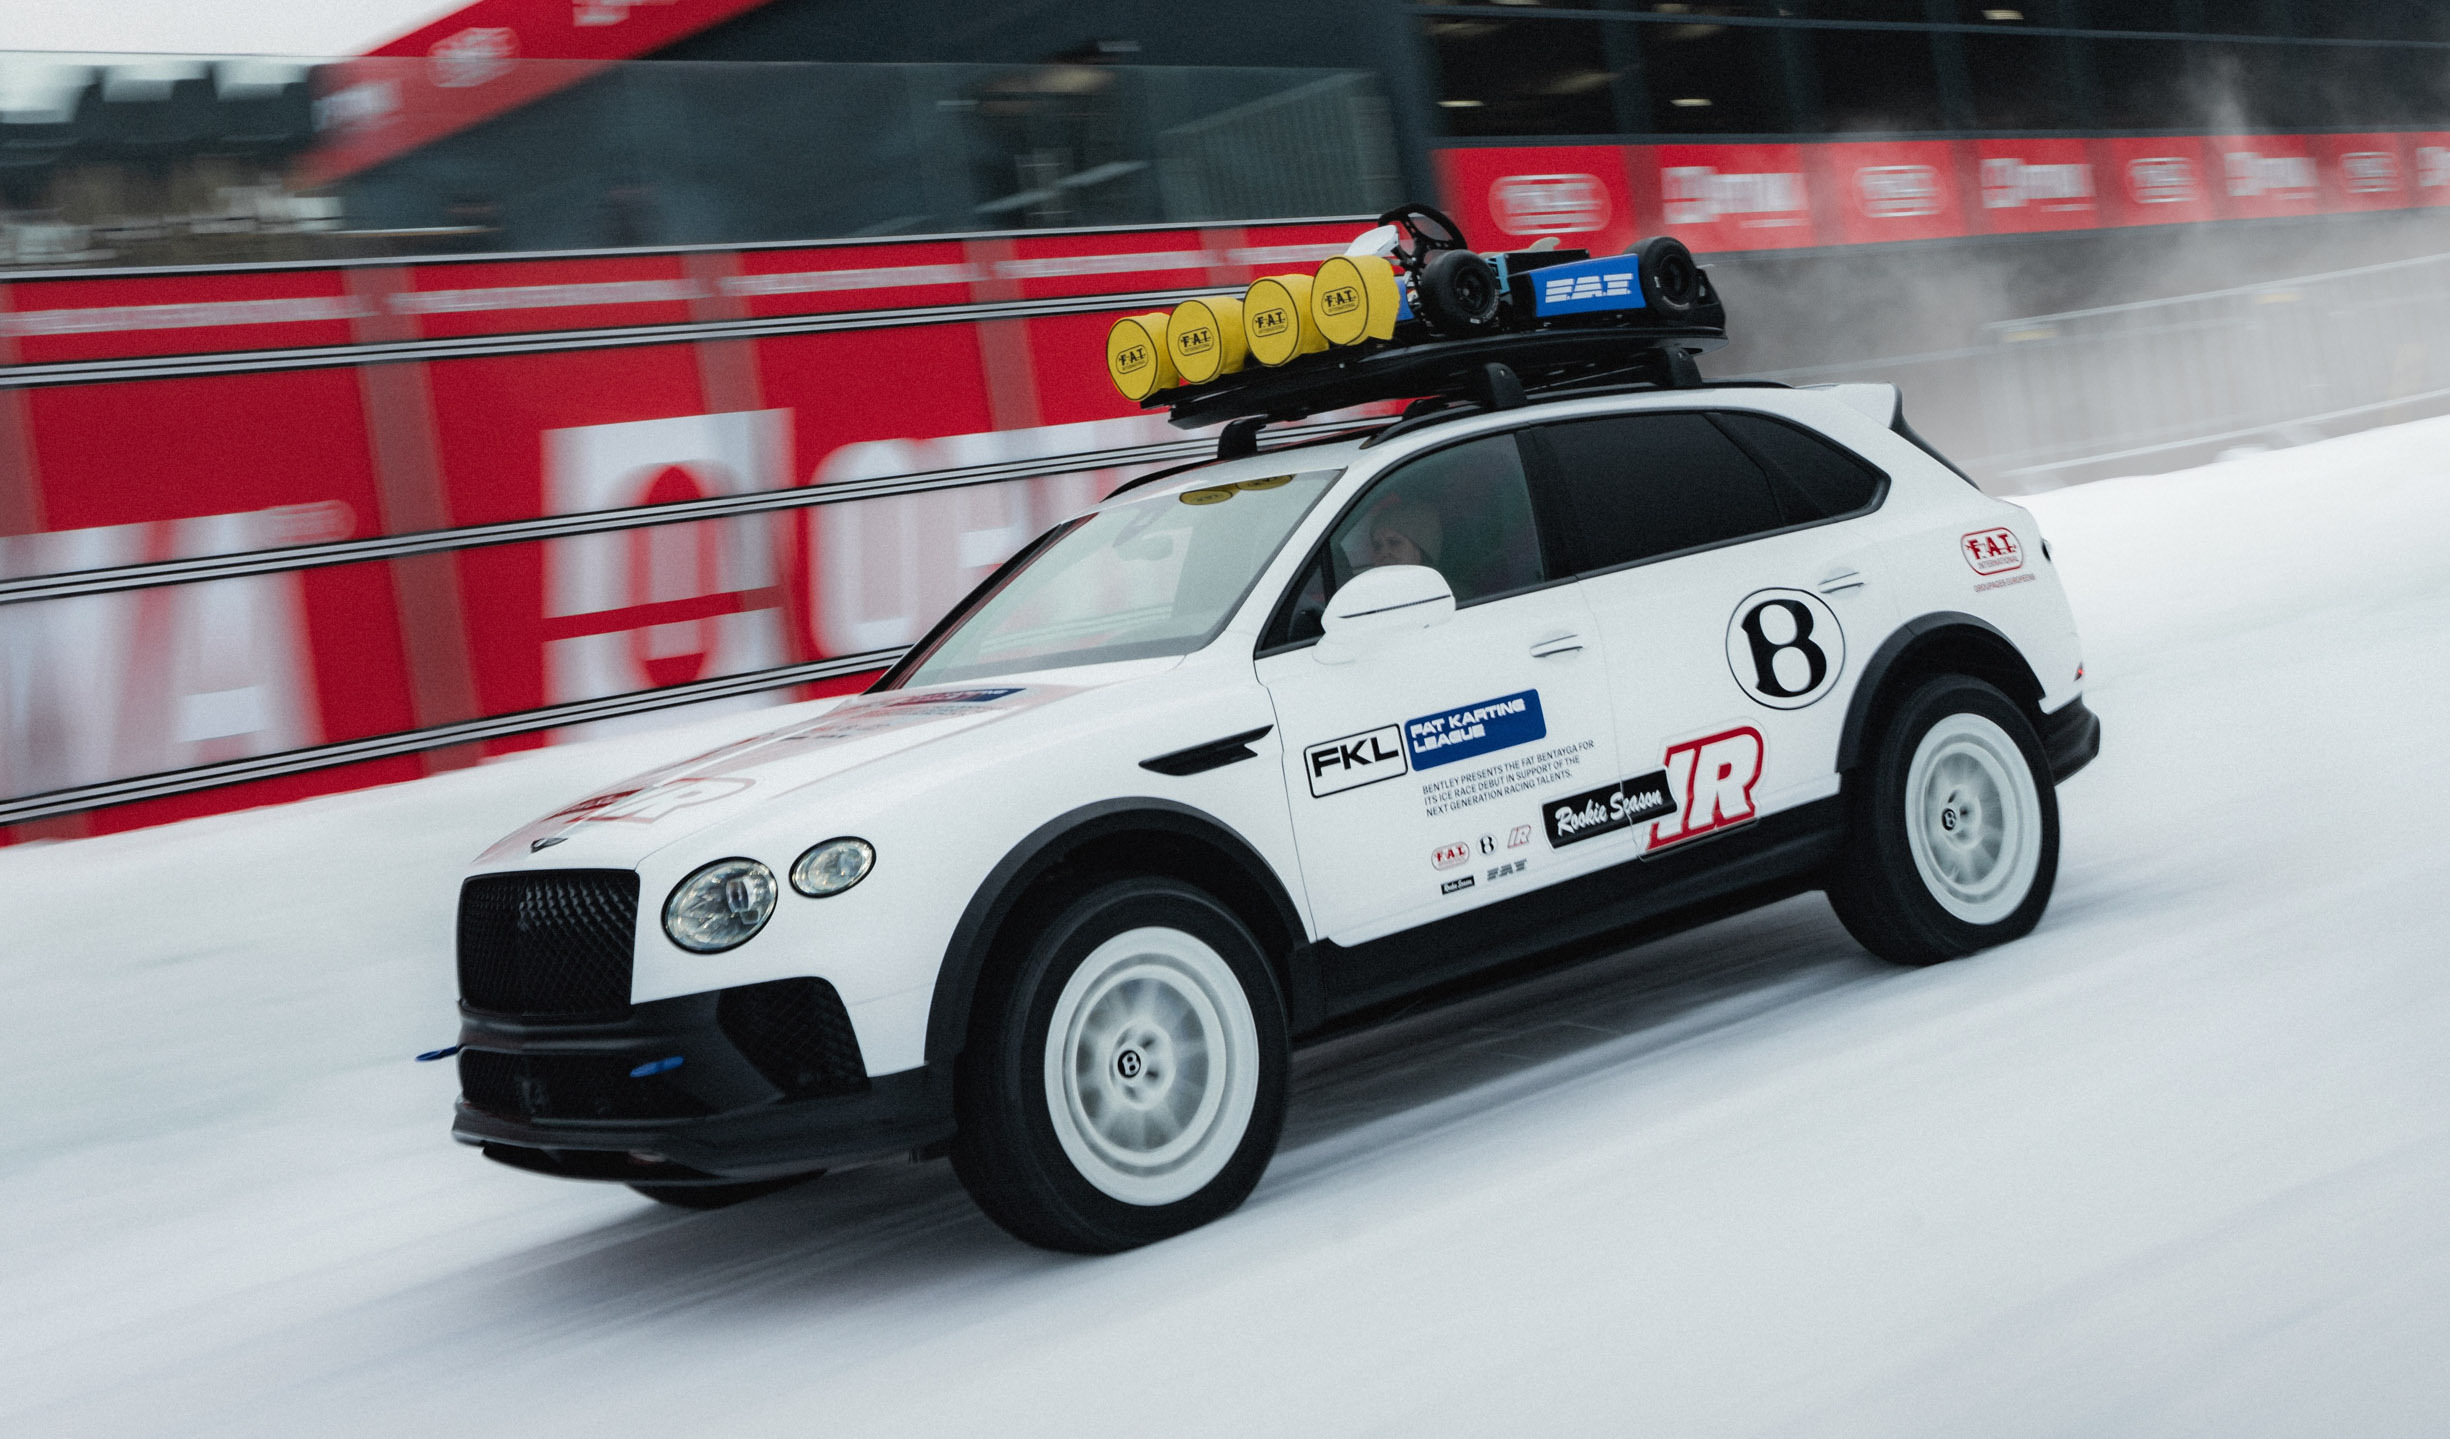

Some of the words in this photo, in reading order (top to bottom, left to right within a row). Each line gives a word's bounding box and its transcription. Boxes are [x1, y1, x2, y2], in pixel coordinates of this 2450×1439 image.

[1410, 718, 1445, 739] FAT
[1449, 698, 1526, 729] KARTING
[1413, 723, 1486, 754] LEAGUE
[1310, 737, 1399, 778] FKL
[1422, 776, 1459, 795] BENTLEY
[1461, 766, 1504, 785] PRESENTS
[1505, 761, 1520, 772] THE
[1521, 757, 1535, 768] FAT
[1537, 745, 1578, 763] BENTAYGA
[1579, 740, 1594, 752] FOR
[1424, 794, 1438, 805] ITS
[1439, 791, 1452, 802] ICE
[1454, 784, 1476, 798] RACE
[1478, 777, 1504, 791] DEBUT
[1506, 774, 1515, 783] IN
[1516, 763, 1551, 781] SUPPORT
[1553, 761, 1564, 771] OF
[1565, 756, 1580, 767] THE
[1426, 804, 1449, 817] NEXT
[1450, 789, 1503, 810] GENERATION
[1504, 780, 1535, 796] RACING
[1536, 770, 1573, 787] TALENTS.
[1555, 799, 1608, 837] Rookie
[1609, 789, 1663, 821] Season
